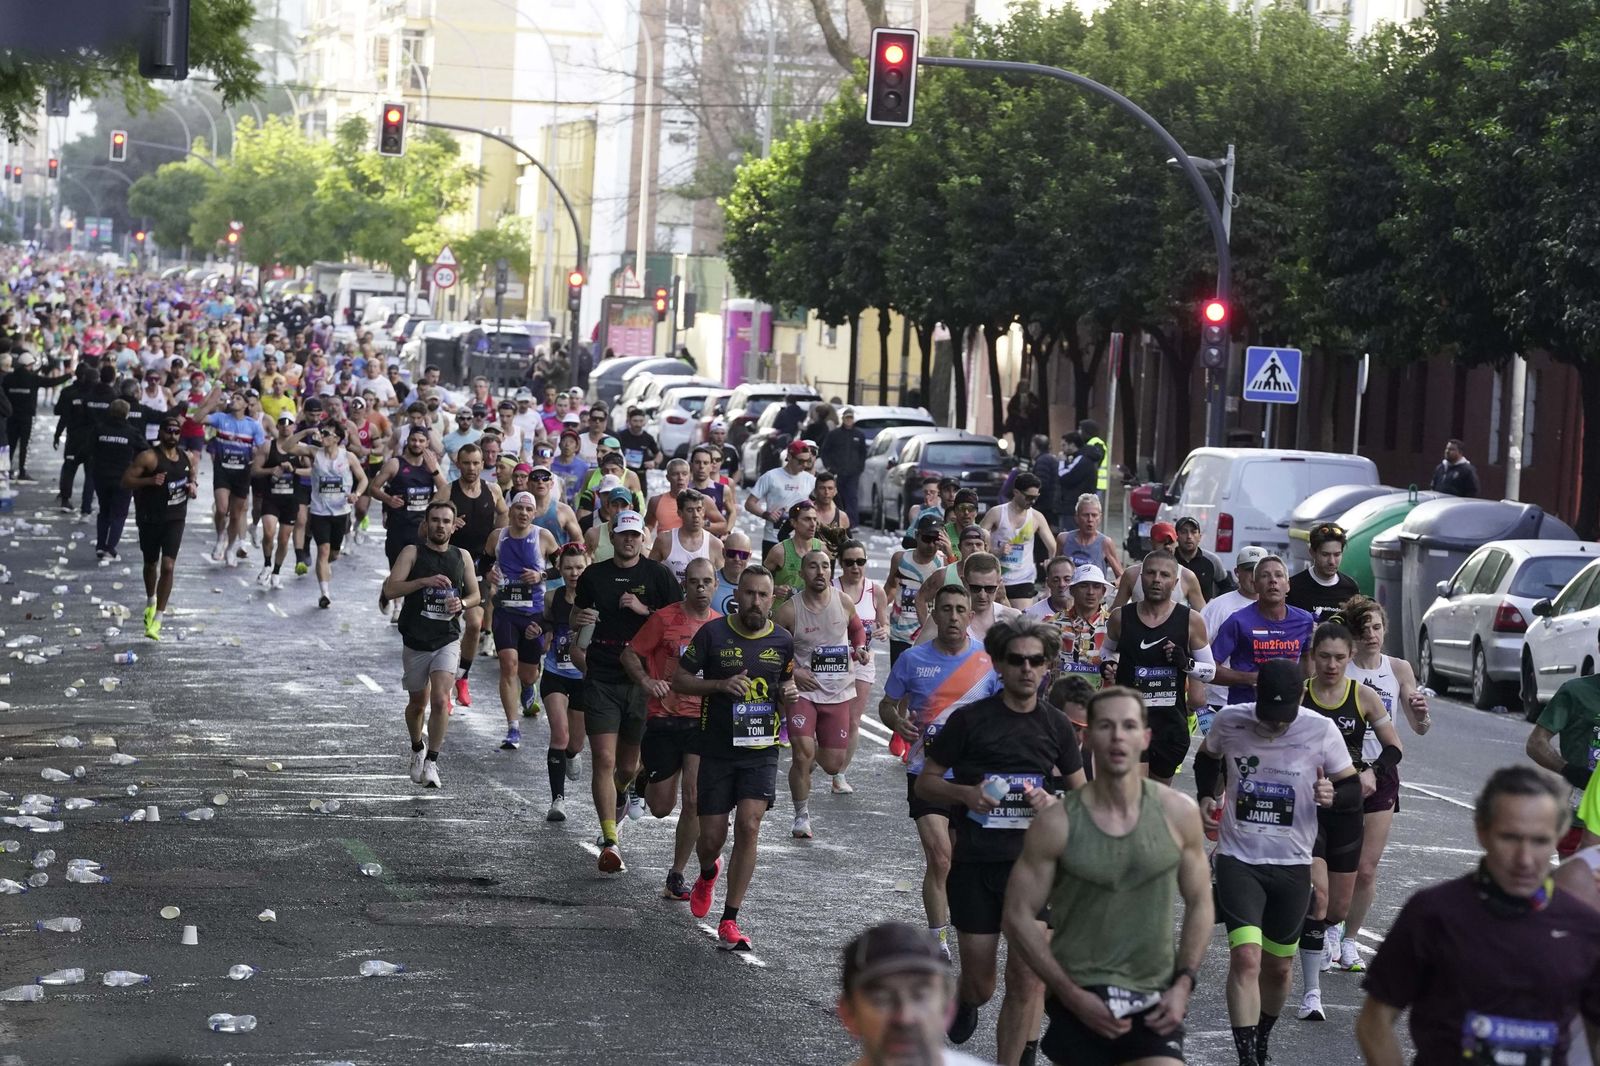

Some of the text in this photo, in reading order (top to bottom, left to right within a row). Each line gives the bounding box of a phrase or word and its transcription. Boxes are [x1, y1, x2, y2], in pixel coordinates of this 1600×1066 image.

[438, 272, 451, 281] 30
[1253, 639, 1300, 651] Run2Forty2
[813, 664, 847, 672] JAVIHDEZ
[1073, 664, 1097, 672] ZURICH
[747, 726, 764, 736] TONI
[1005, 793, 1023, 801] 5012
[1255, 800, 1273, 809] 5233
[1246, 810, 1281, 824] JAIME
[1494, 1022, 1550, 1040] ZURICH
